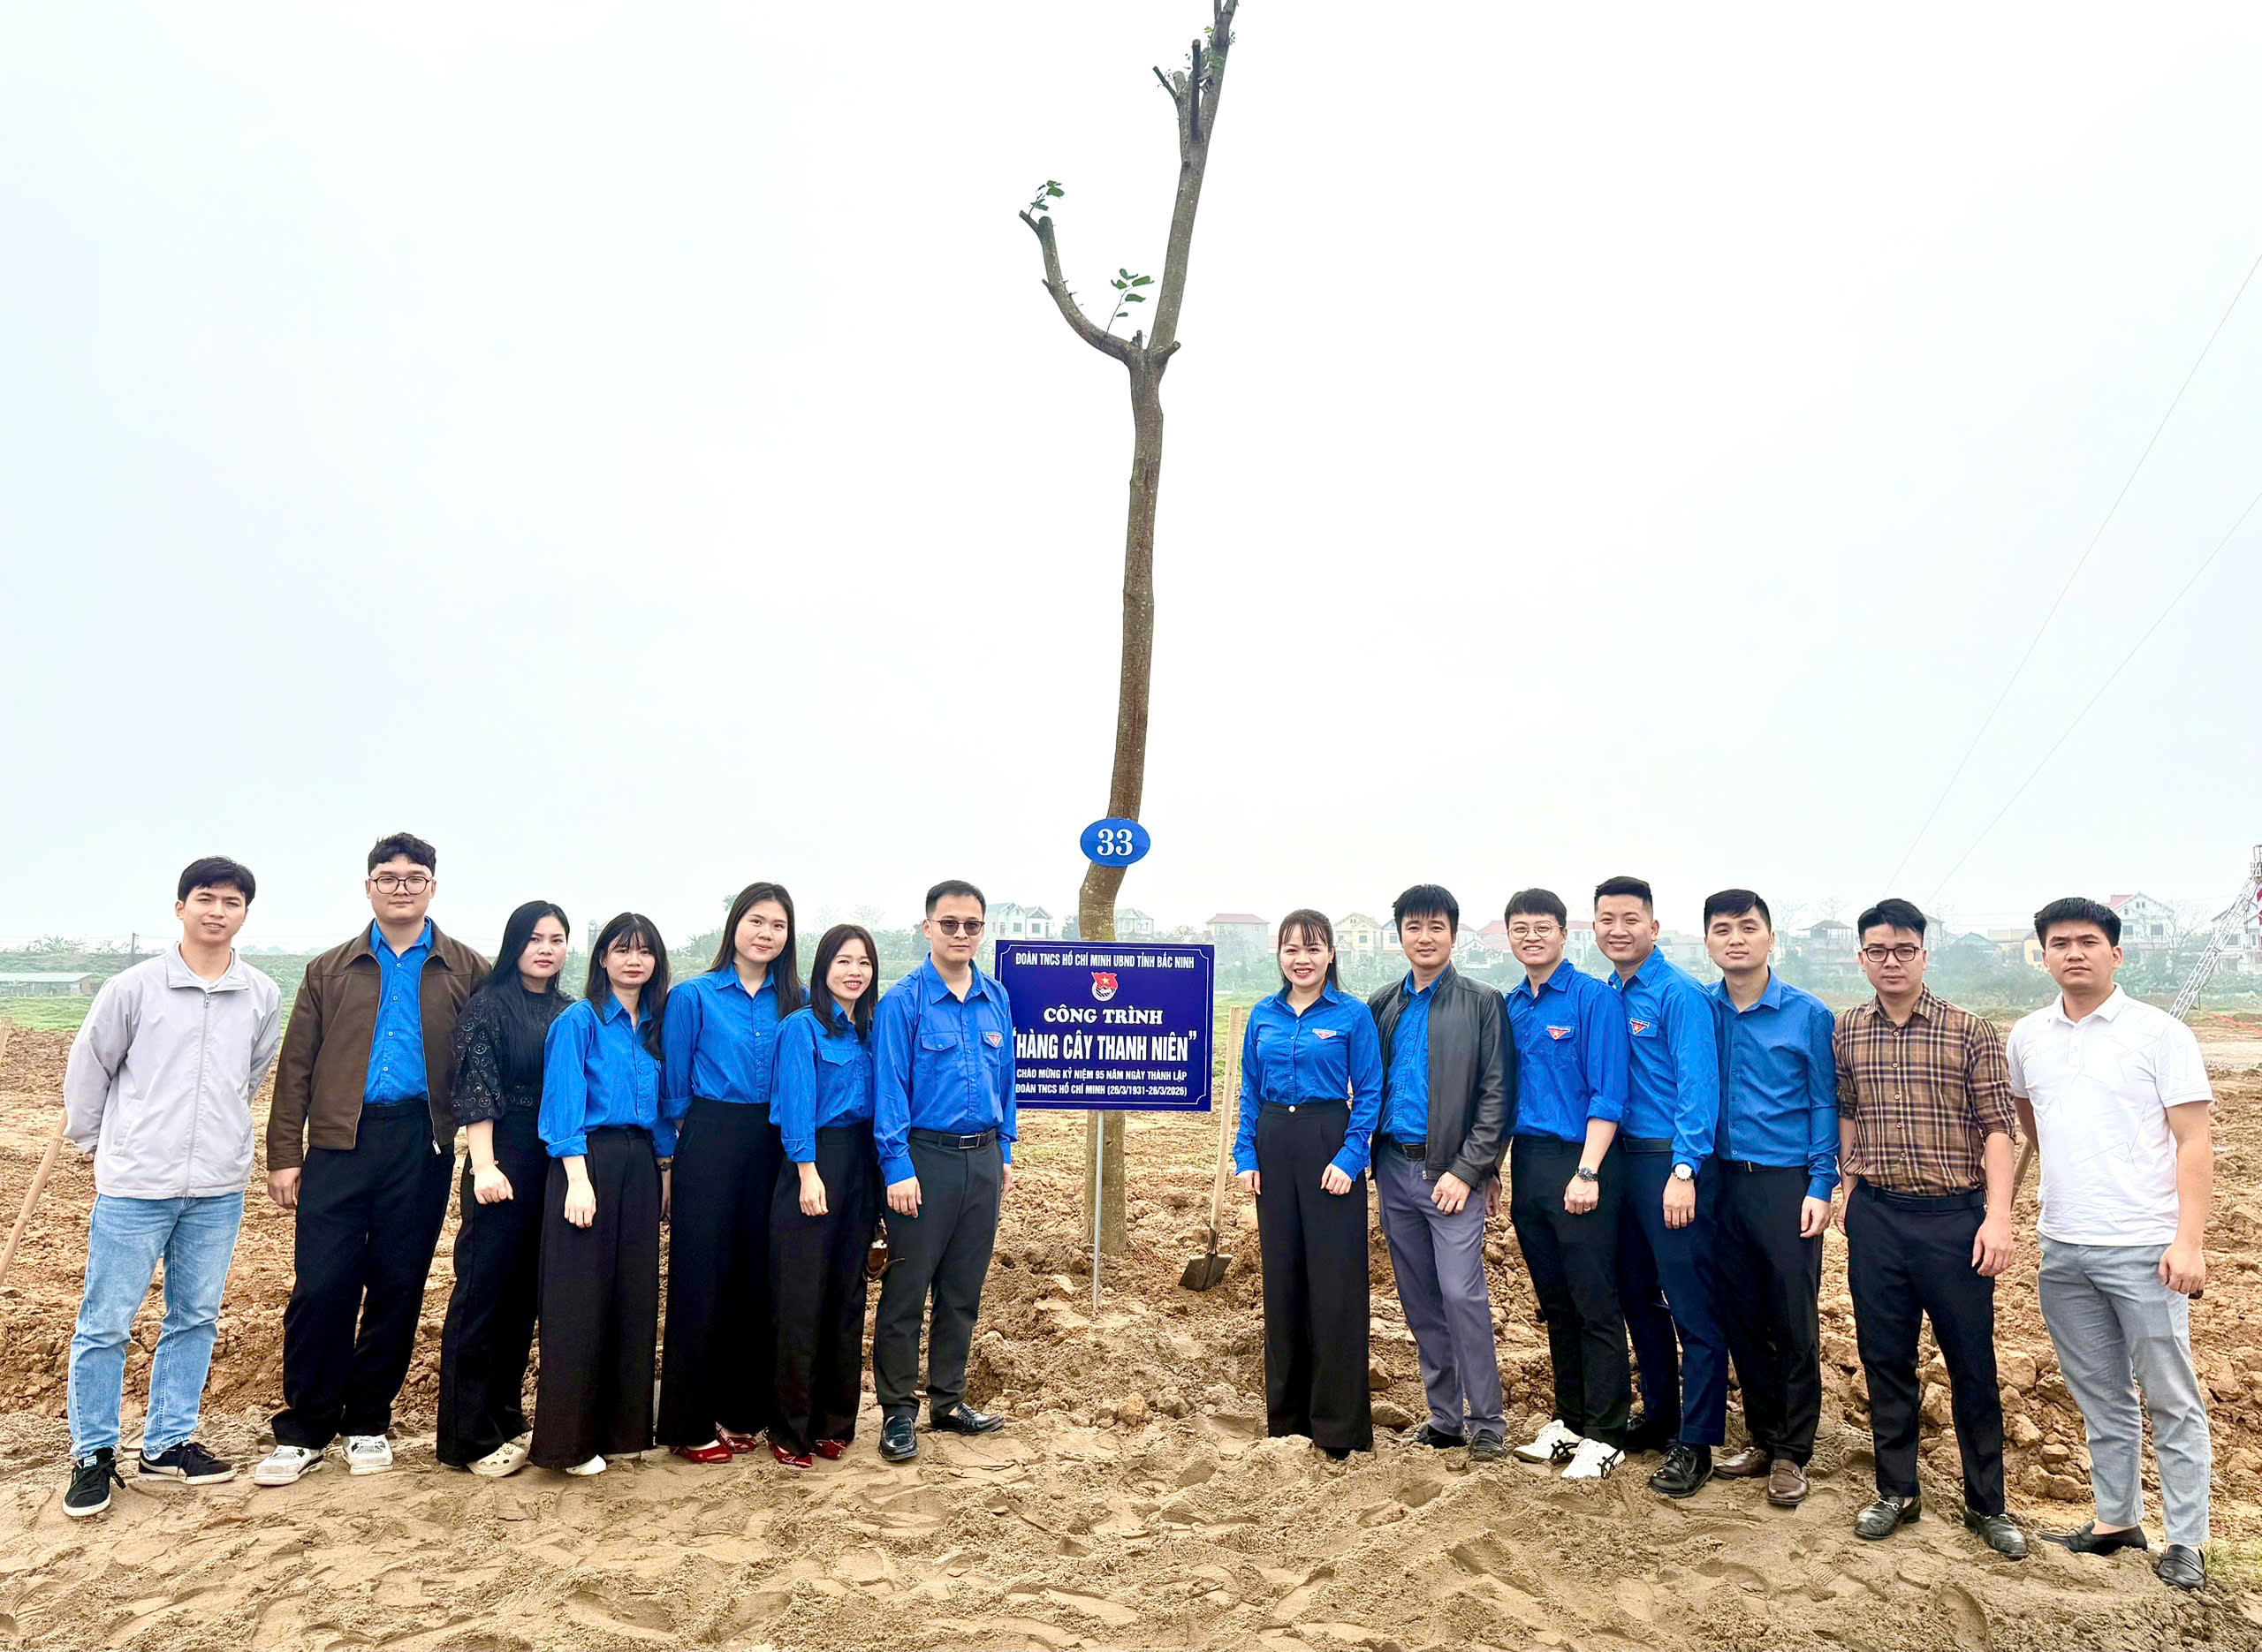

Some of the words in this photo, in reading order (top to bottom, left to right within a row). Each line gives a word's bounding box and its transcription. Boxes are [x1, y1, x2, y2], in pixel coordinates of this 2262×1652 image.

[1097, 828, 1134, 857] 33
[1015, 950, 1038, 966] ĐOÀN
[1040, 953, 1060, 966] TNCS
[1074, 951, 1089, 966] CHÍ
[1089, 954, 1112, 967] MINH
[1113, 954, 1135, 967] UBND
[1136, 951, 1156, 968] TỈNH
[1157, 951, 1173, 969] BẮC
[1174, 956, 1196, 969] NINH
[1044, 1004, 1098, 1024] CÔNG
[1102, 1004, 1164, 1025] TRÌNH
[1063, 1029, 1094, 1060] CÂY
[1097, 1034, 1148, 1061] THANH
[1016, 1067, 1037, 1079] CHÀO
[1074, 1068, 1094, 1081] NIỆM
[1095, 1070, 1105, 1080] 95
[1105, 1068, 1124, 1080] NĂM
[1125, 1068, 1146, 1080] NGÀY
[1147, 1069, 1172, 1081] THÀNH
[1015, 1082, 1036, 1094] ĐOÀN
[1037, 1084, 1058, 1095] TNCS
[1071, 1083, 1084, 1095] CHÍ
[1085, 1085, 1106, 1095] MINH
[1107, 1085, 1188, 1096] (26/3/1931-26/3/2026)
